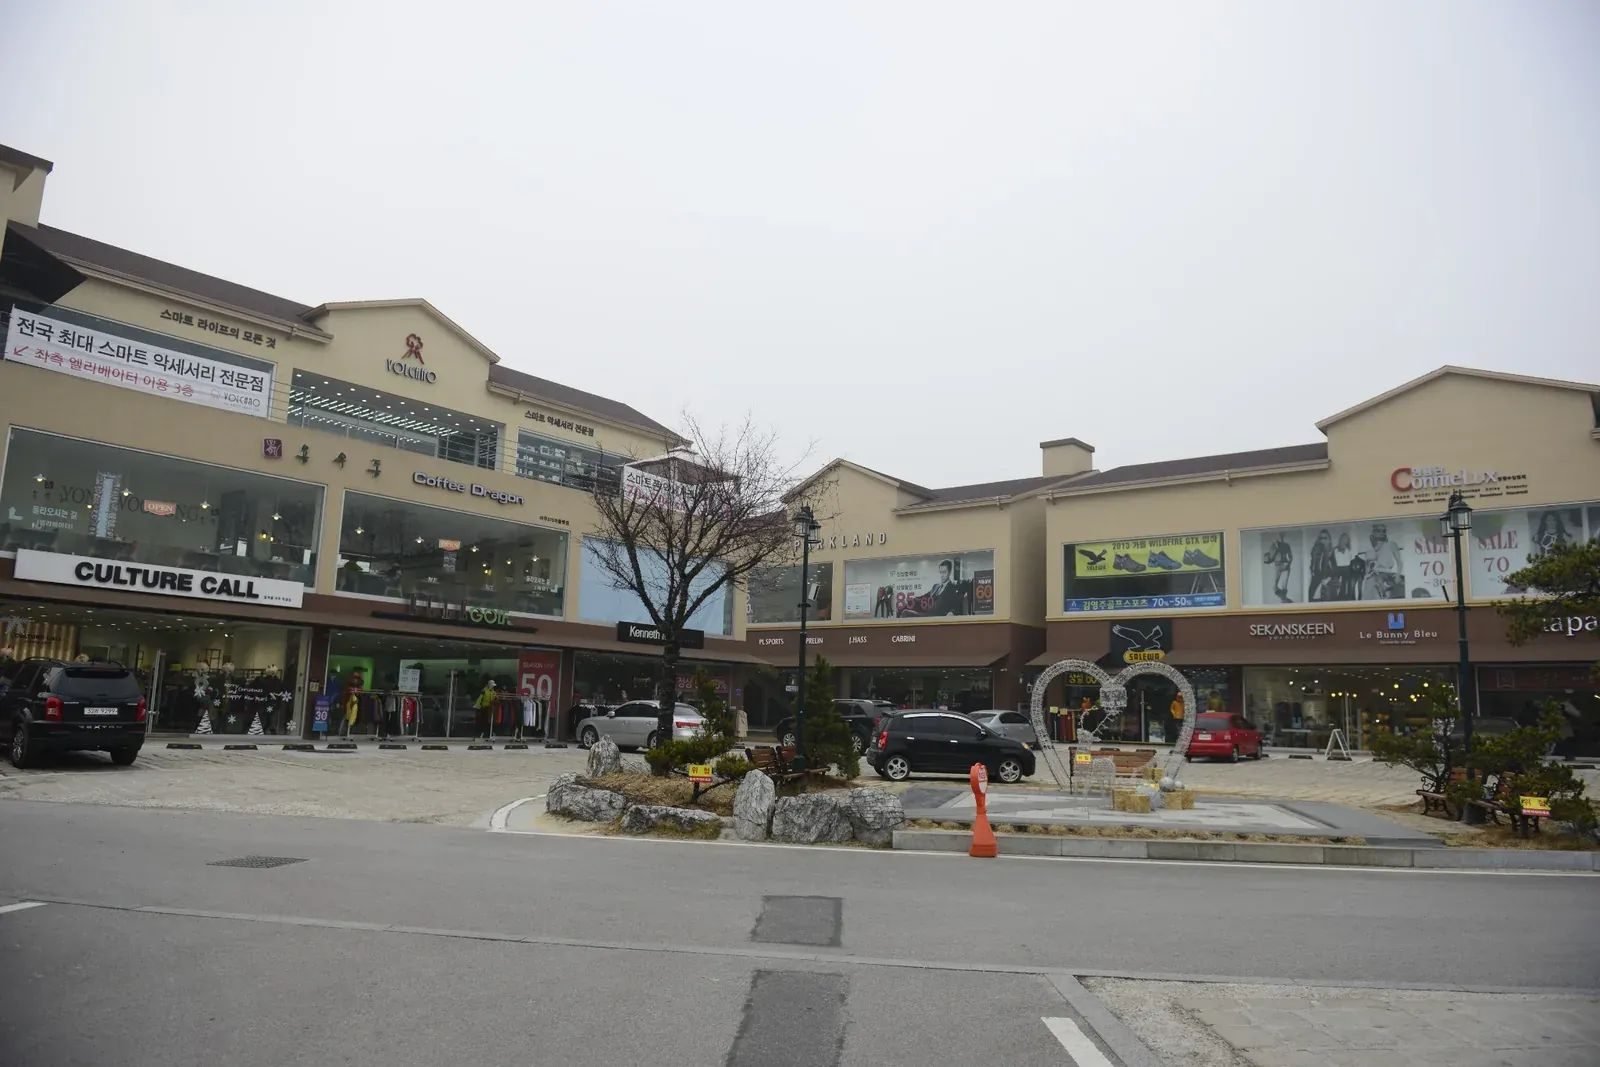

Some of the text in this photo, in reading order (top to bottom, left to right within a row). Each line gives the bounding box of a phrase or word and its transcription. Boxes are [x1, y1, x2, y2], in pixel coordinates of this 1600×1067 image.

[160, 309, 276, 349] 스마트 라이프의 모든 것
[17, 317, 264, 392] 전국 최대 스마트 악세서리 전문점
[34, 347, 65, 367] 좌측
[143, 375, 169, 392] 이용
[174, 383, 194, 397] 3층
[525, 410, 545, 422] 스마트
[547, 416, 574, 431] 악세서리
[413, 471, 525, 505] Coffee Dragon
[148, 502, 173, 513] OPEN
[1185, 537, 1200, 545] GTX
[1420, 560, 1444, 577] 70
[1483, 556, 1510, 572] 70
[75, 561, 259, 599] CULTURE CALL
[976, 584, 992, 599] 60
[896, 592, 915, 610] 85
[629, 625, 660, 640] Kenneth
[892, 635, 916, 643] CABRINI
[1359, 629, 1438, 640] Le Bunny Bleu
[1129, 653, 1160, 661] SALEWA
[522, 673, 552, 700] 50
[315, 710, 328, 721] 30
